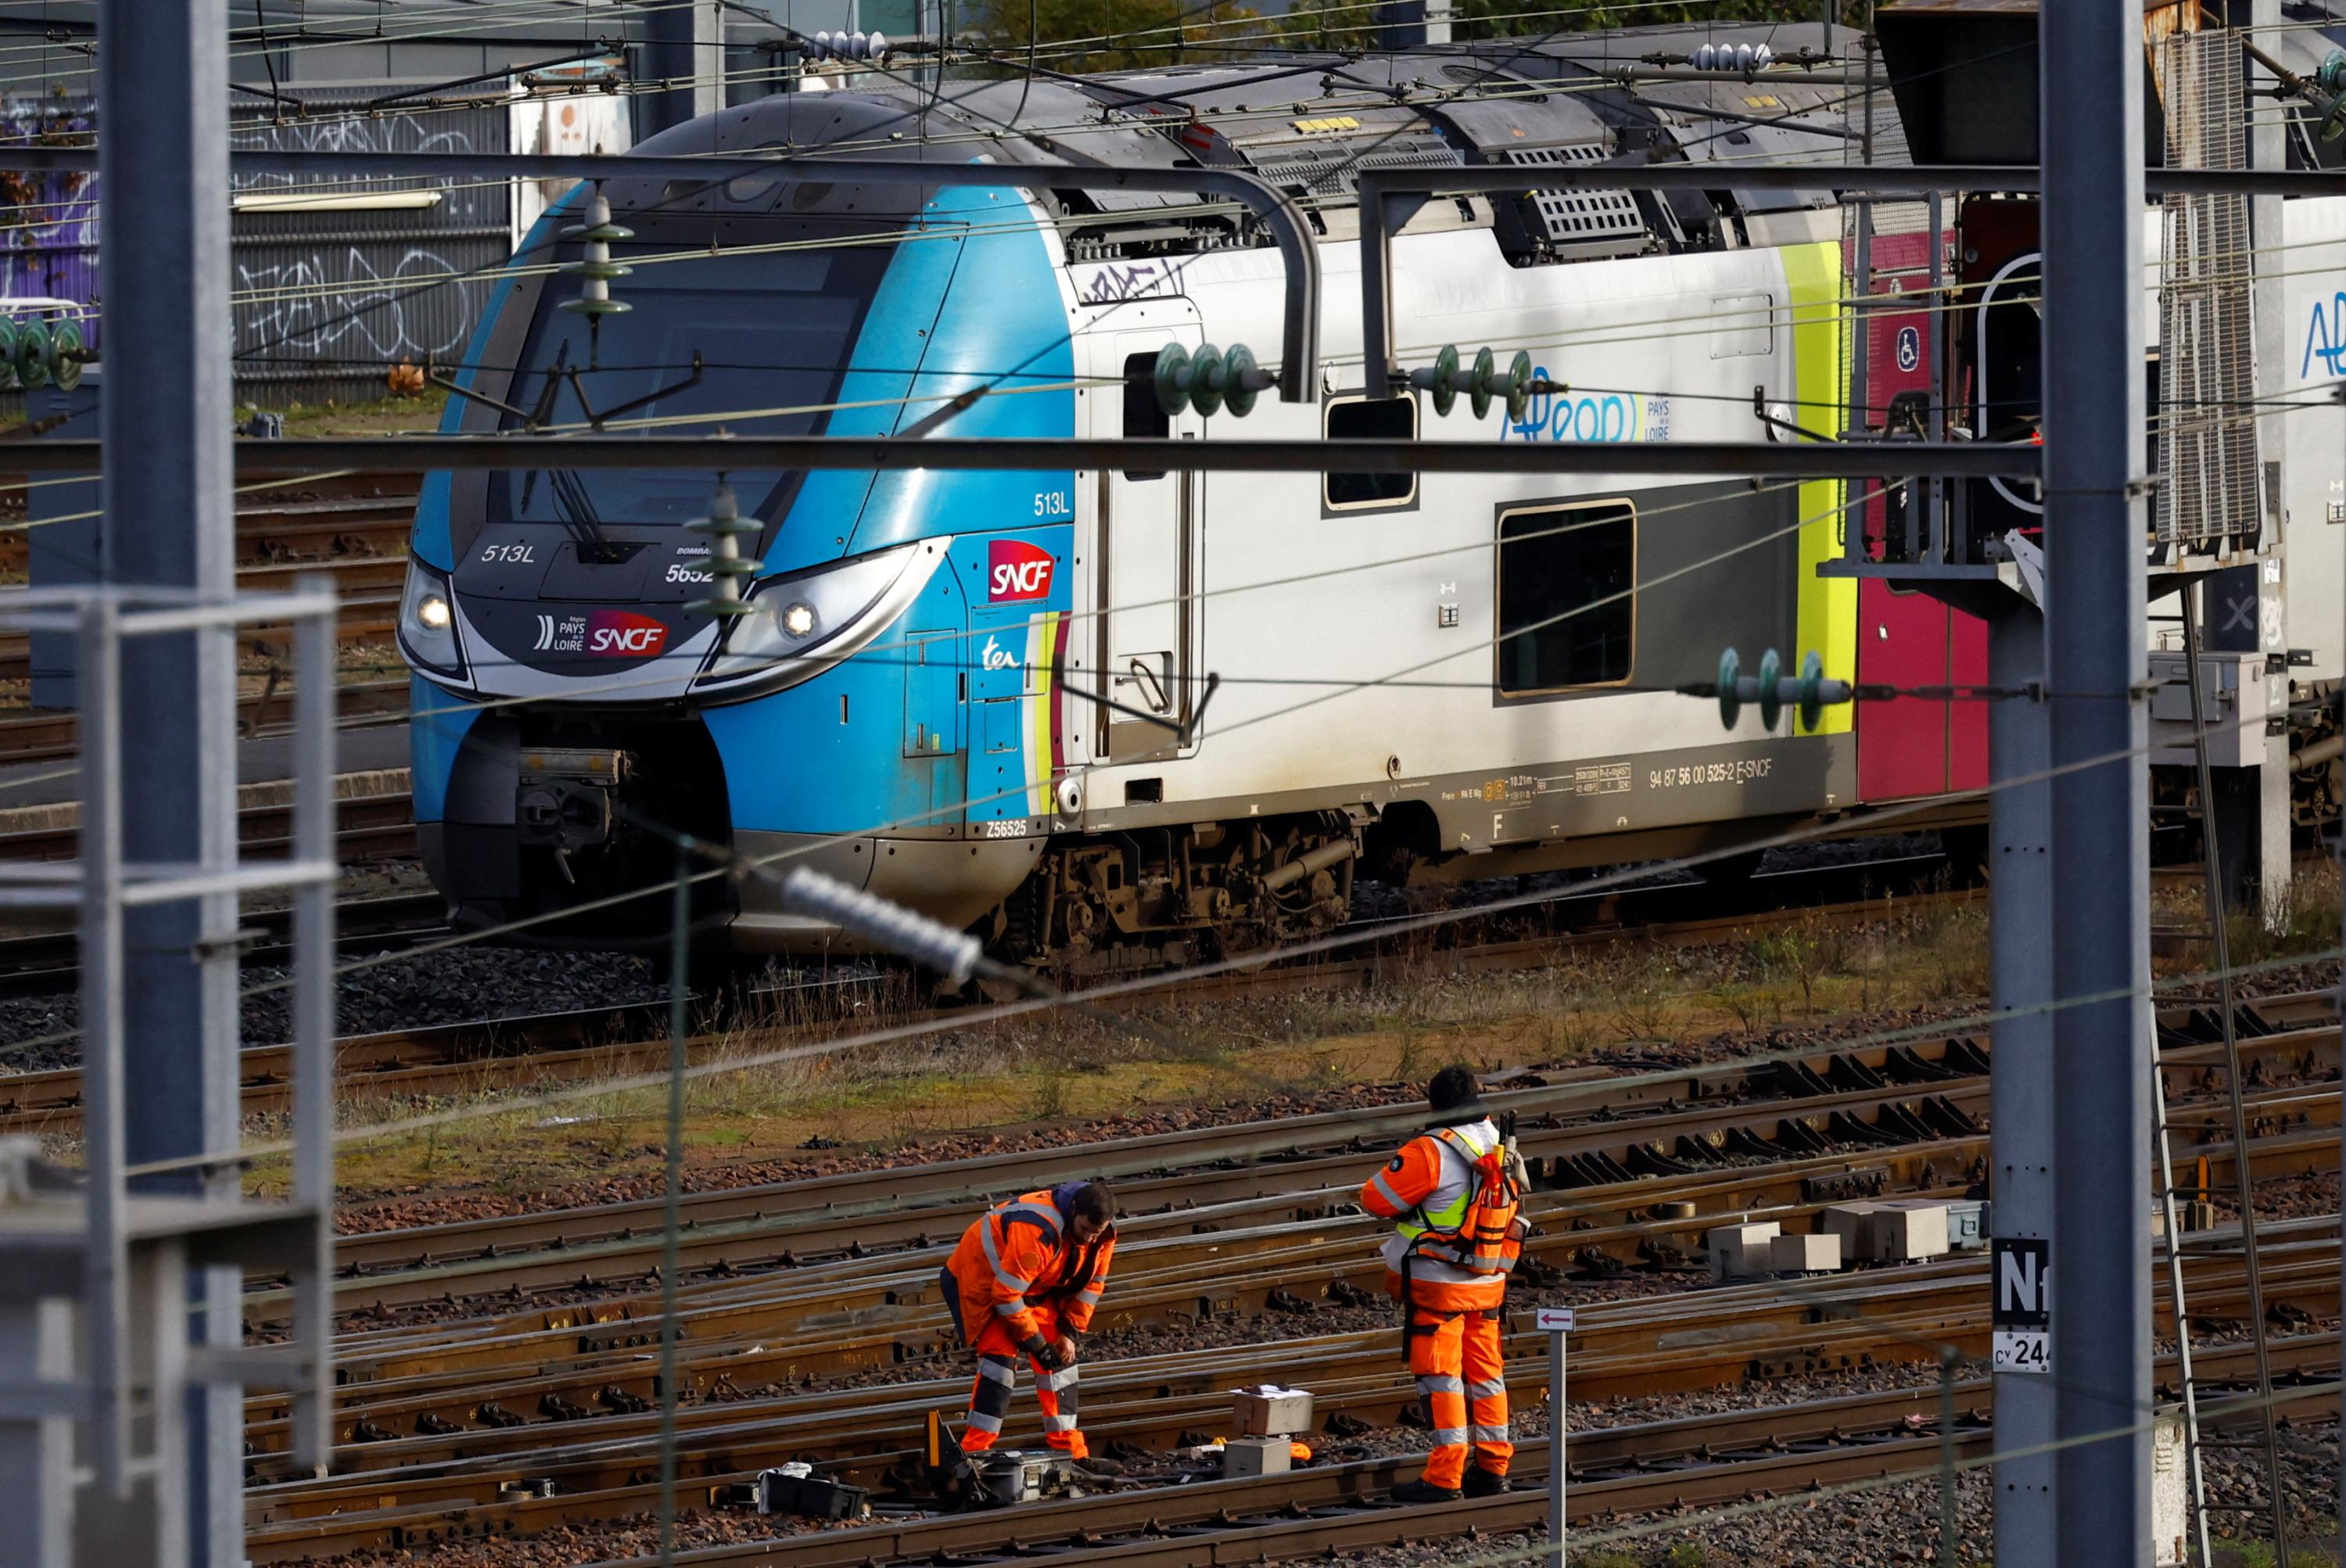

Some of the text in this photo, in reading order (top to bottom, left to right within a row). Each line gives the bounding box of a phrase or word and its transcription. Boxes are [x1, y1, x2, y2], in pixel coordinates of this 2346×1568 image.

[1648, 400, 1670, 416] PAYS
[1645, 426, 1669, 443] LOIRE
[1034, 491, 1070, 516] 513L
[481, 545, 535, 562] 513L
[990, 561, 1051, 594] SNCF
[559, 623, 586, 634] PAYS
[554, 640, 583, 651] LOIRE
[590, 628, 663, 651] SNCF
[982, 633, 1021, 671] ter
[1650, 770, 1662, 788] 94
[1664, 769, 1676, 787] 87
[1678, 767, 1691, 785] 56
[1693, 766, 1705, 784] 00
[1707, 763, 1734, 782] 525-2
[1737, 759, 1772, 784] F-SNCF
[986, 820, 1027, 838] Z56525
[1494, 813, 1503, 839] F
